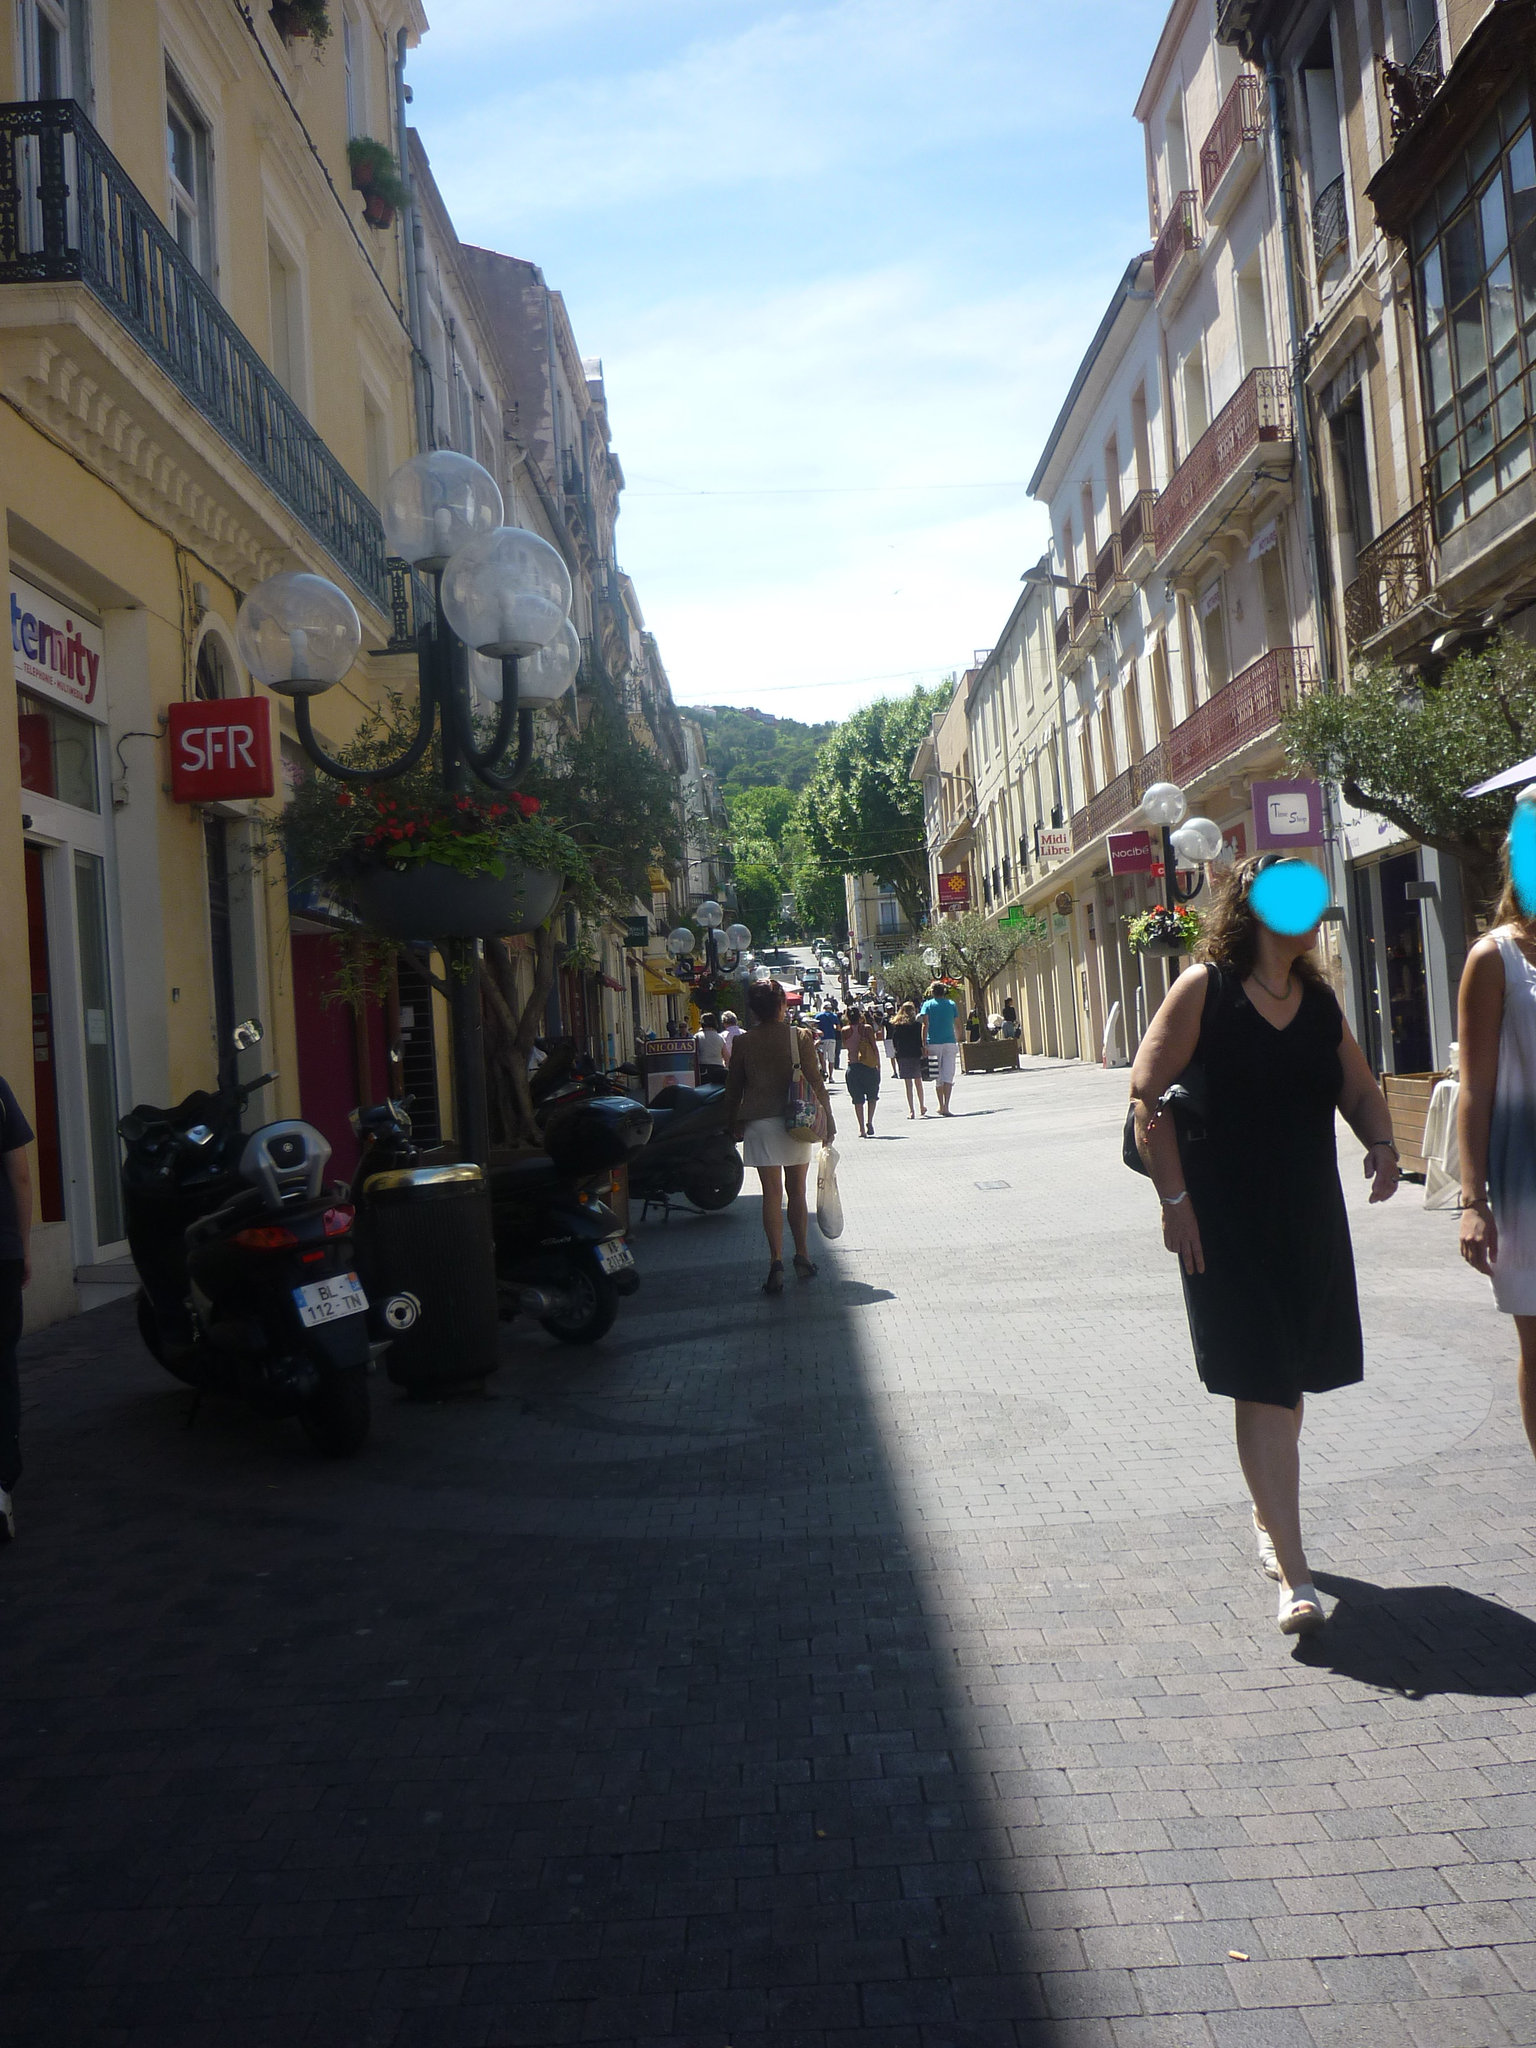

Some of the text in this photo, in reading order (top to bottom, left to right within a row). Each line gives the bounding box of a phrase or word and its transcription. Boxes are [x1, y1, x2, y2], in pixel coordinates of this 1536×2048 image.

[181, 725, 257, 772] SFR
[1040, 833, 1067, 845] Midi
[1040, 845, 1070, 856] Libre
[648, 1041, 693, 1052] NICOLAS
